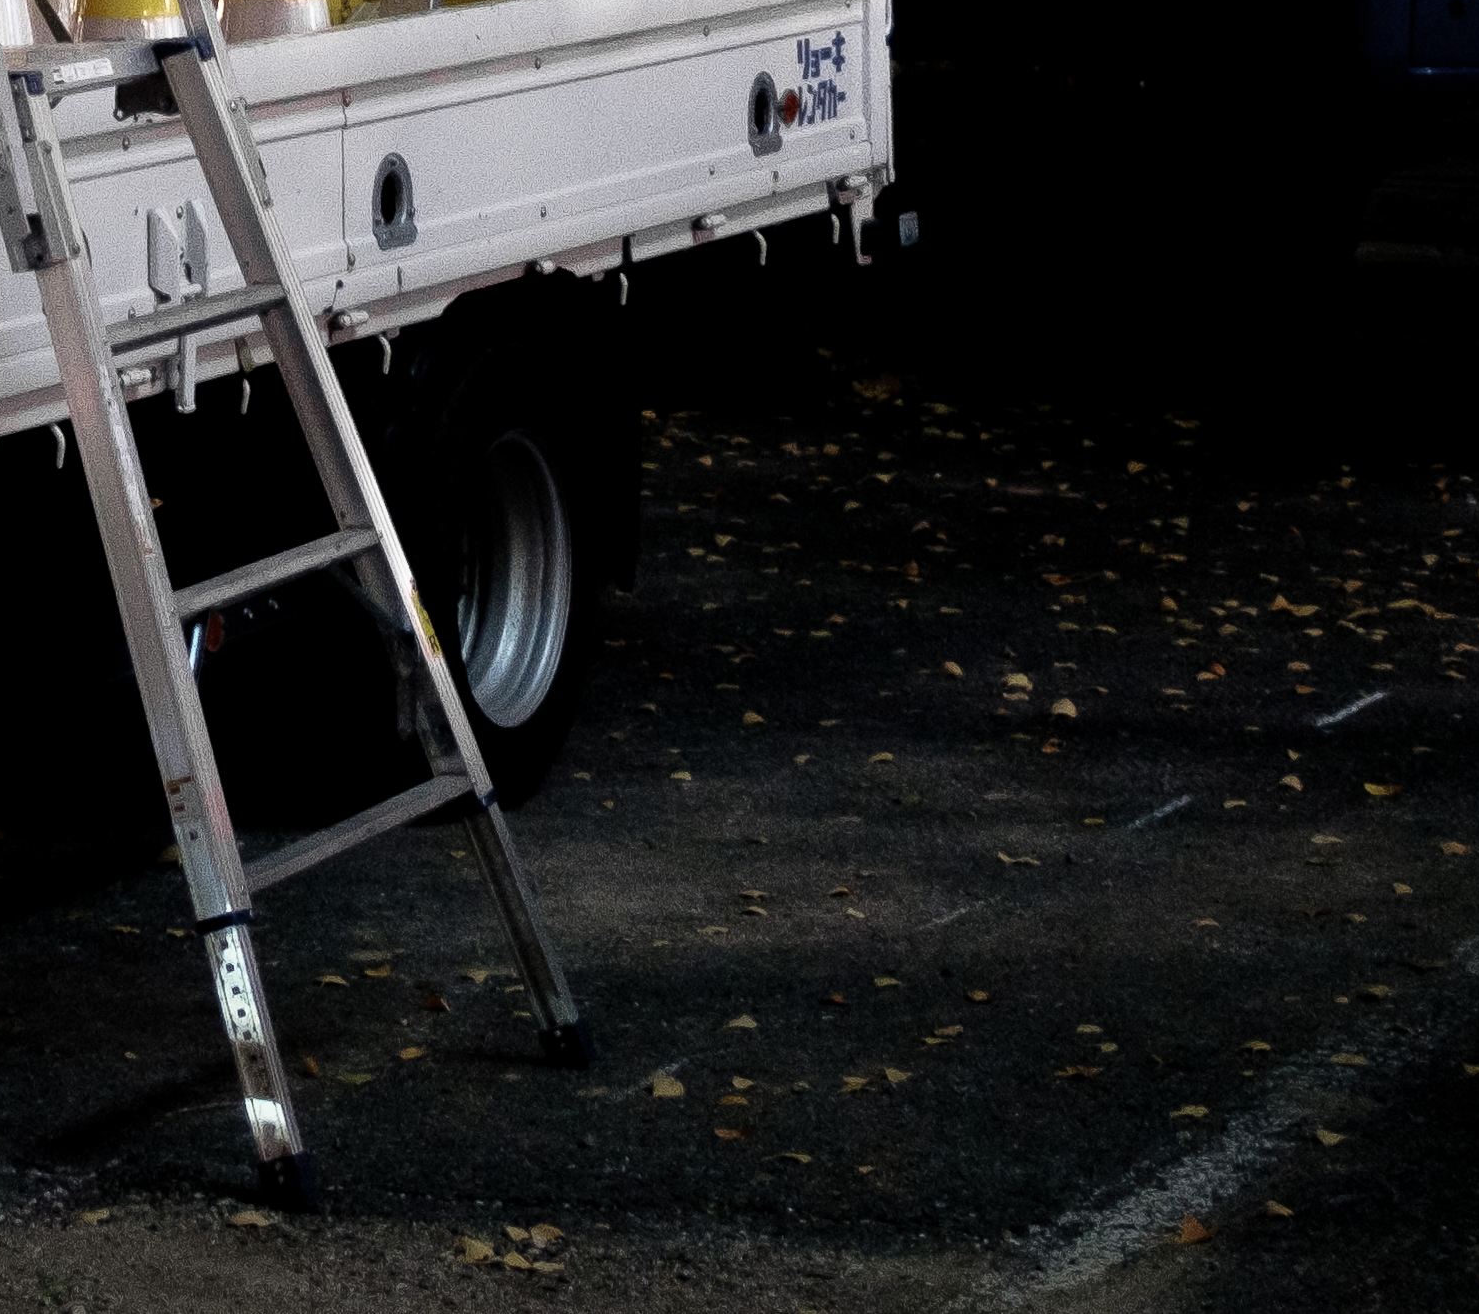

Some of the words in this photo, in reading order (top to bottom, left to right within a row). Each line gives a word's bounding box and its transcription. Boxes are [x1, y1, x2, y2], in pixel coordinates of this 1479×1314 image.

[797, 31, 846, 79] リョーキ
[798, 79, 846, 126] レンタカー
